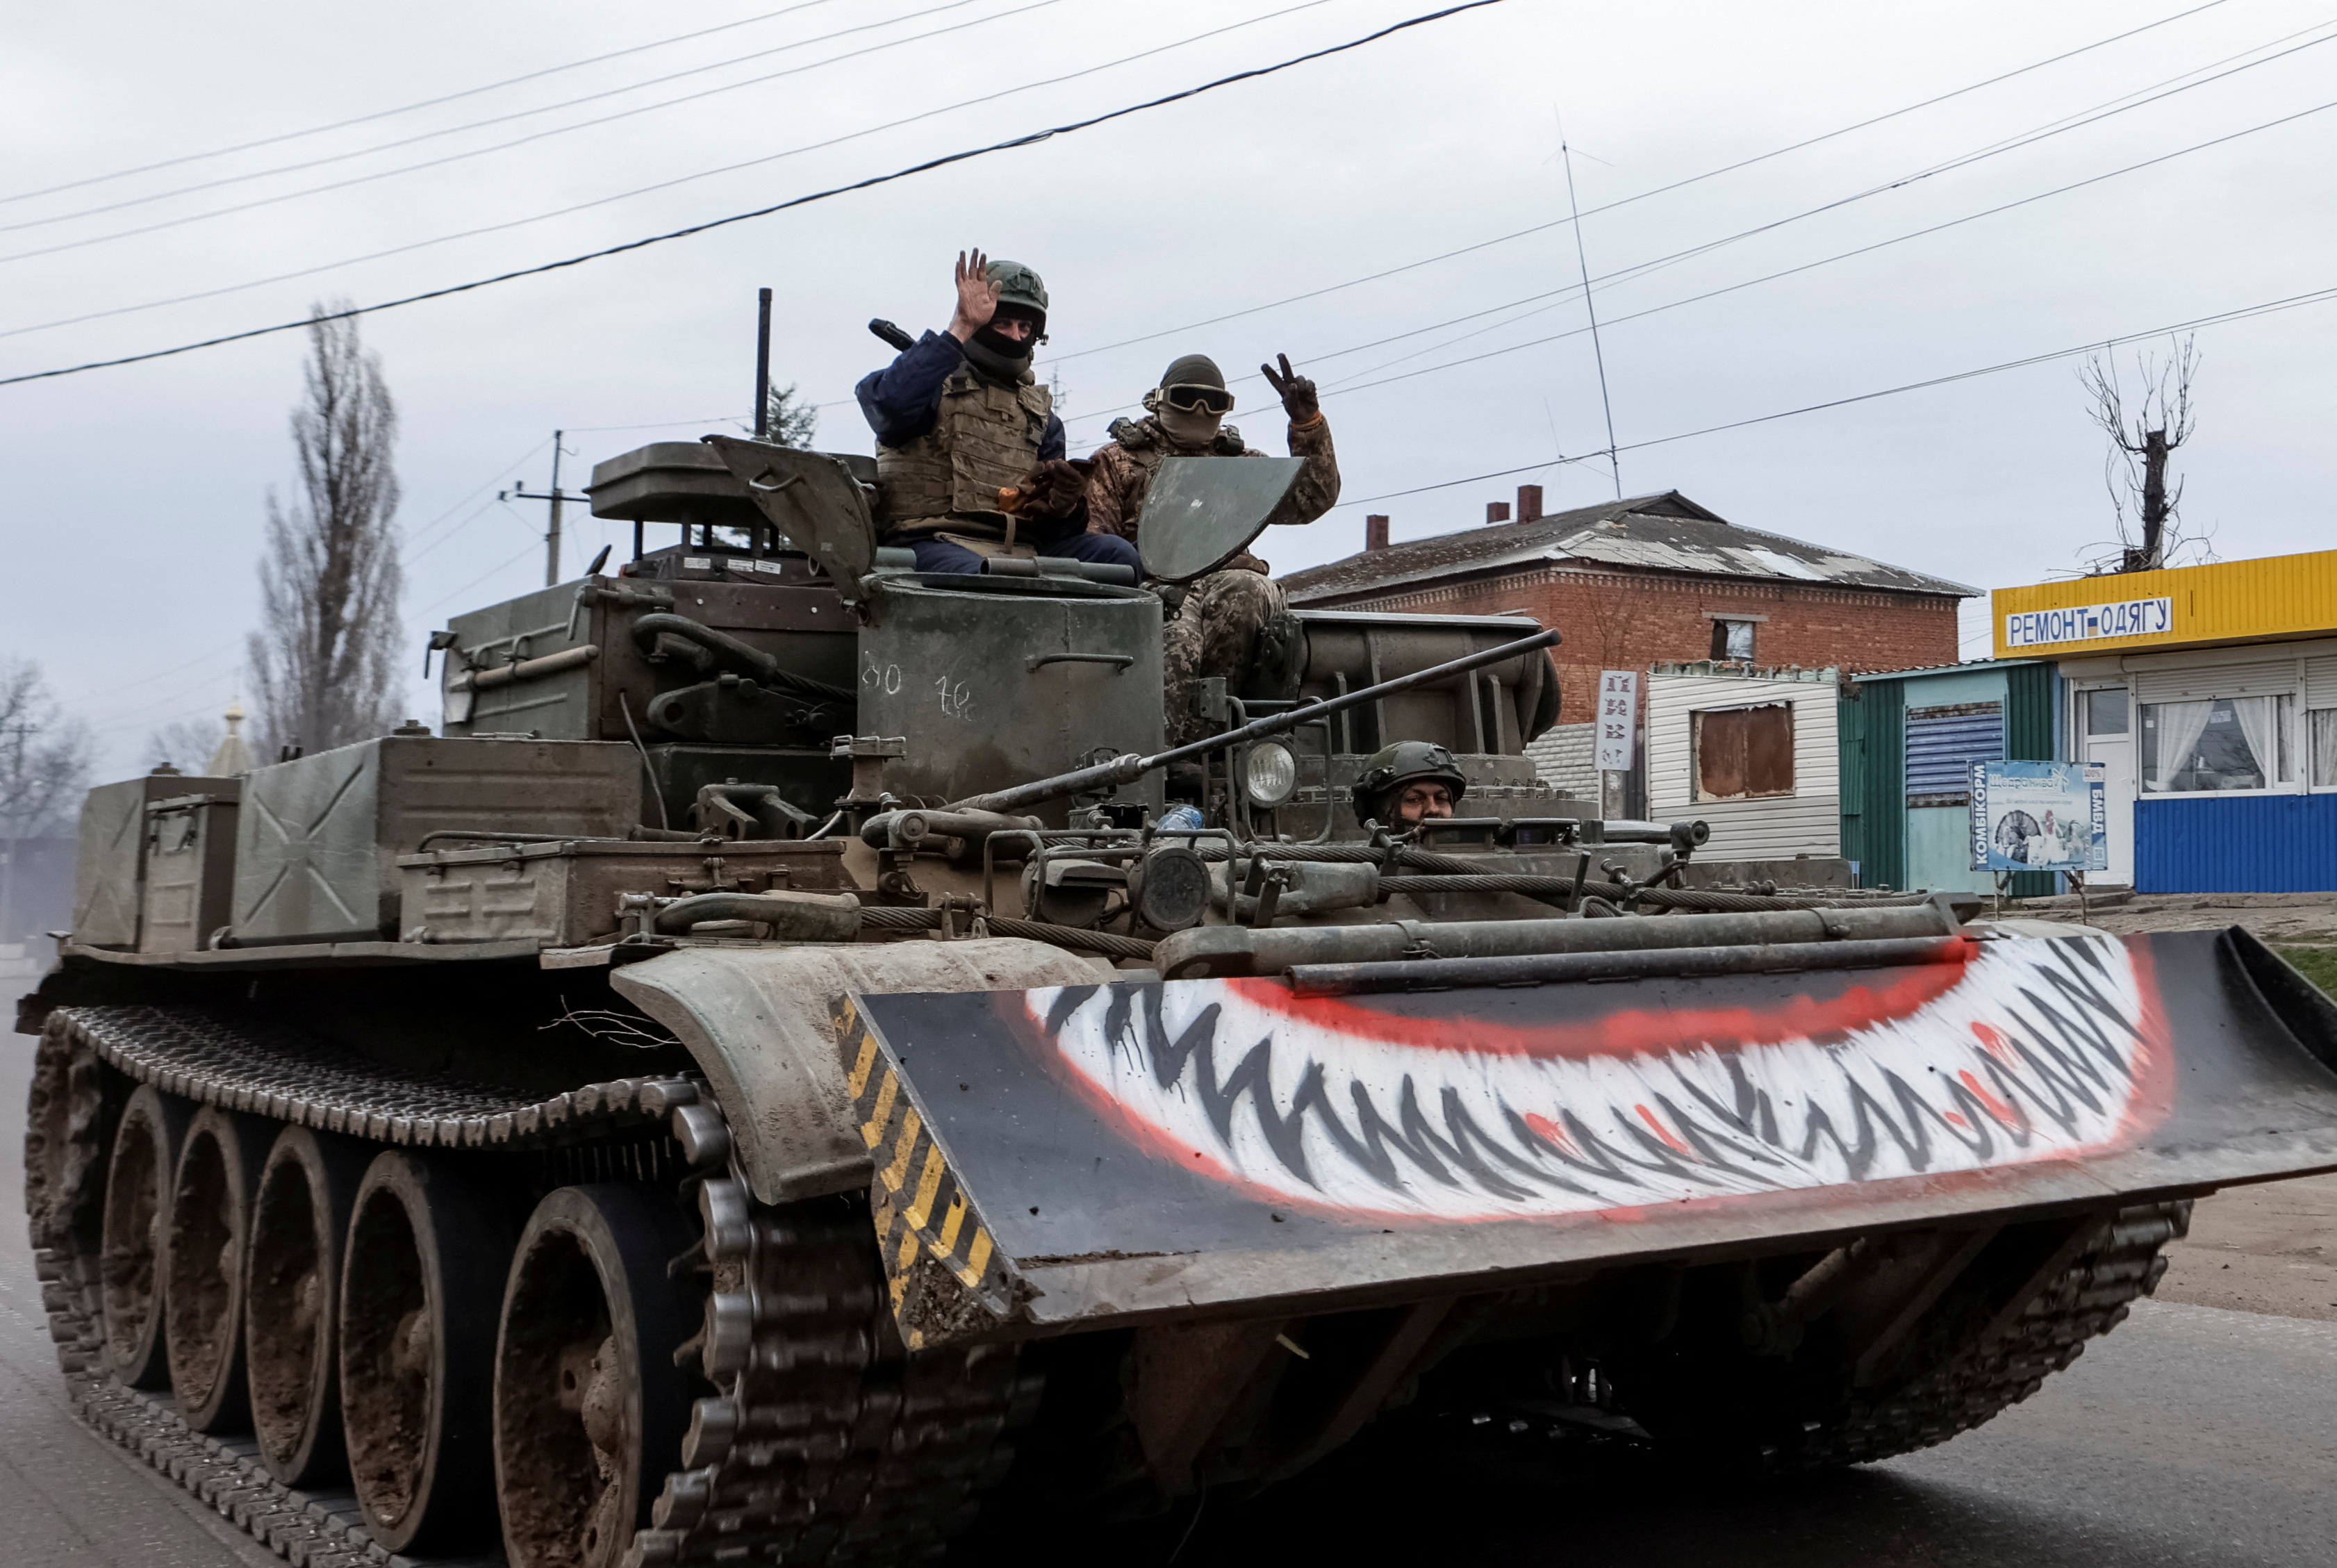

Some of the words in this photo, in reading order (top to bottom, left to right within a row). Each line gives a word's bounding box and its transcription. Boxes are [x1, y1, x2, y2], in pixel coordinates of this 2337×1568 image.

[2010, 608, 2088, 645] РЕМОНТ
[2101, 600, 2167, 635] ОДЯГУ
[1973, 765, 1988, 864] КОМБІКОРМ
[2091, 789, 2104, 834] БМВД
